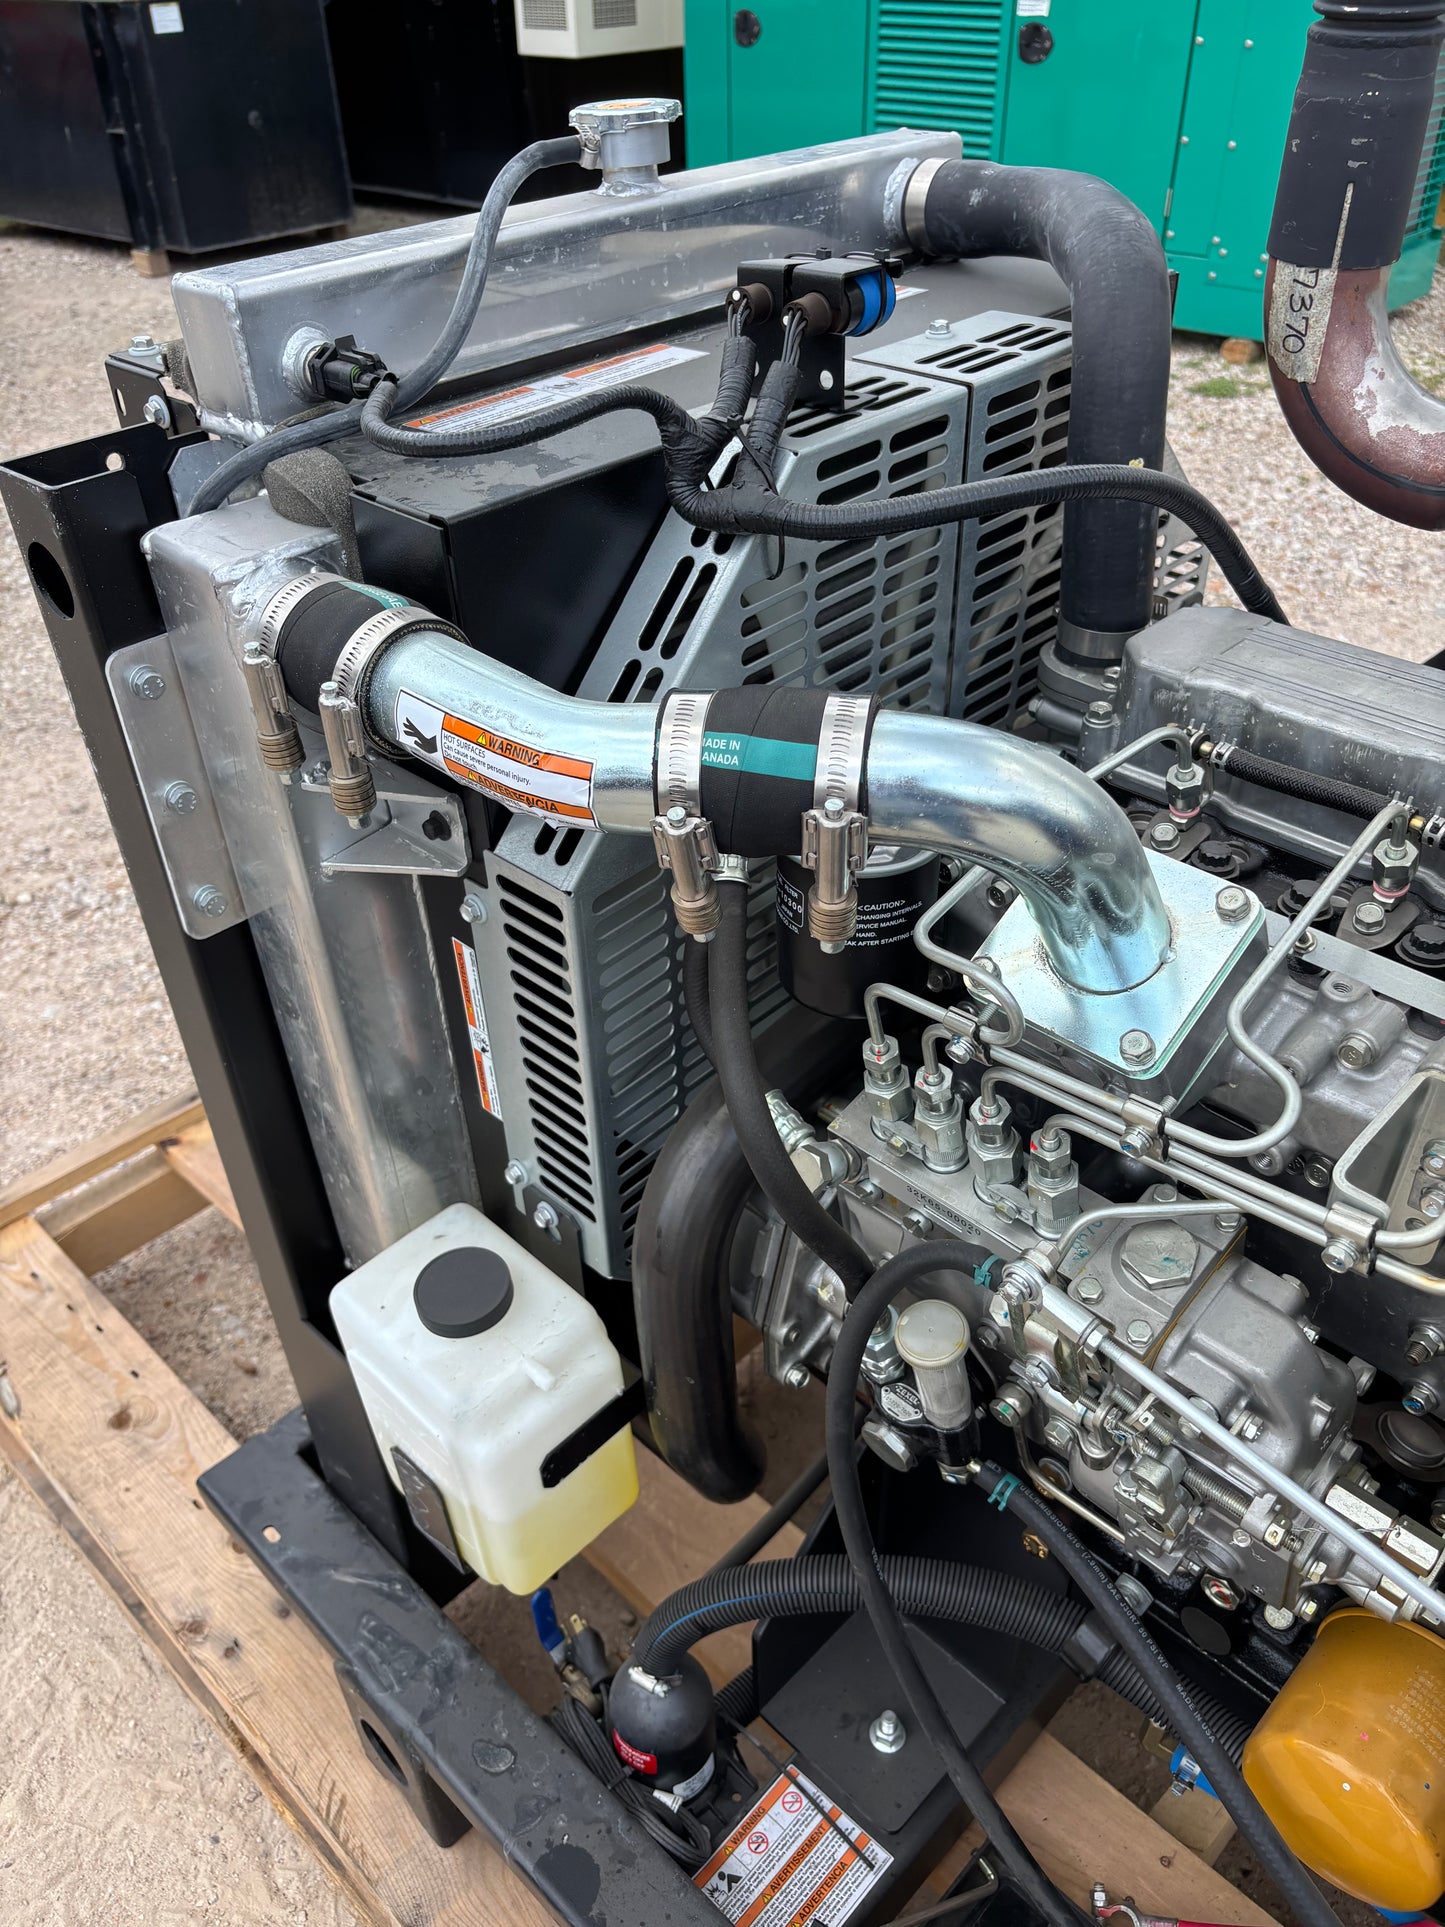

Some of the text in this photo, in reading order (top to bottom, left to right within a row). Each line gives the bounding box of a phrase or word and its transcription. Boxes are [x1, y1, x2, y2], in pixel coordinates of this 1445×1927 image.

[443, 733, 486, 759] HOT SURFACES
[488, 734, 541, 767] WARNING
[702, 752, 739, 766] ANADA
[729, 740, 741, 750] IN
[443, 742, 531, 787] Can cause severe personal injury.
[477, 775, 560, 814] ADVERTENCIA
[785, 884, 798, 899] FILTER
[856, 912, 891, 921] CHANGING
[881, 932, 910, 945] STARTING
[895, 1385, 920, 1405] ZEXEL
[1020, 1485, 1068, 1533] UEL/EMISSION
[1106, 1582, 1122, 1601] SAE
[1119, 1600, 1140, 1626] J30R7
[1138, 1627, 1148, 1639] 50
[1147, 1639, 1160, 1655] PSI
[1157, 1653, 1170, 1670] WP
[1175, 1683, 1195, 1712] MADE
[1193, 1710, 1203, 1724] IN
[1201, 1722, 1217, 1744] USA
[730, 1805, 767, 1846] WARNING
[769, 1824, 827, 1894] AVERTISSEMENT
[799, 1860, 849, 1922] ADVERTENCIA
